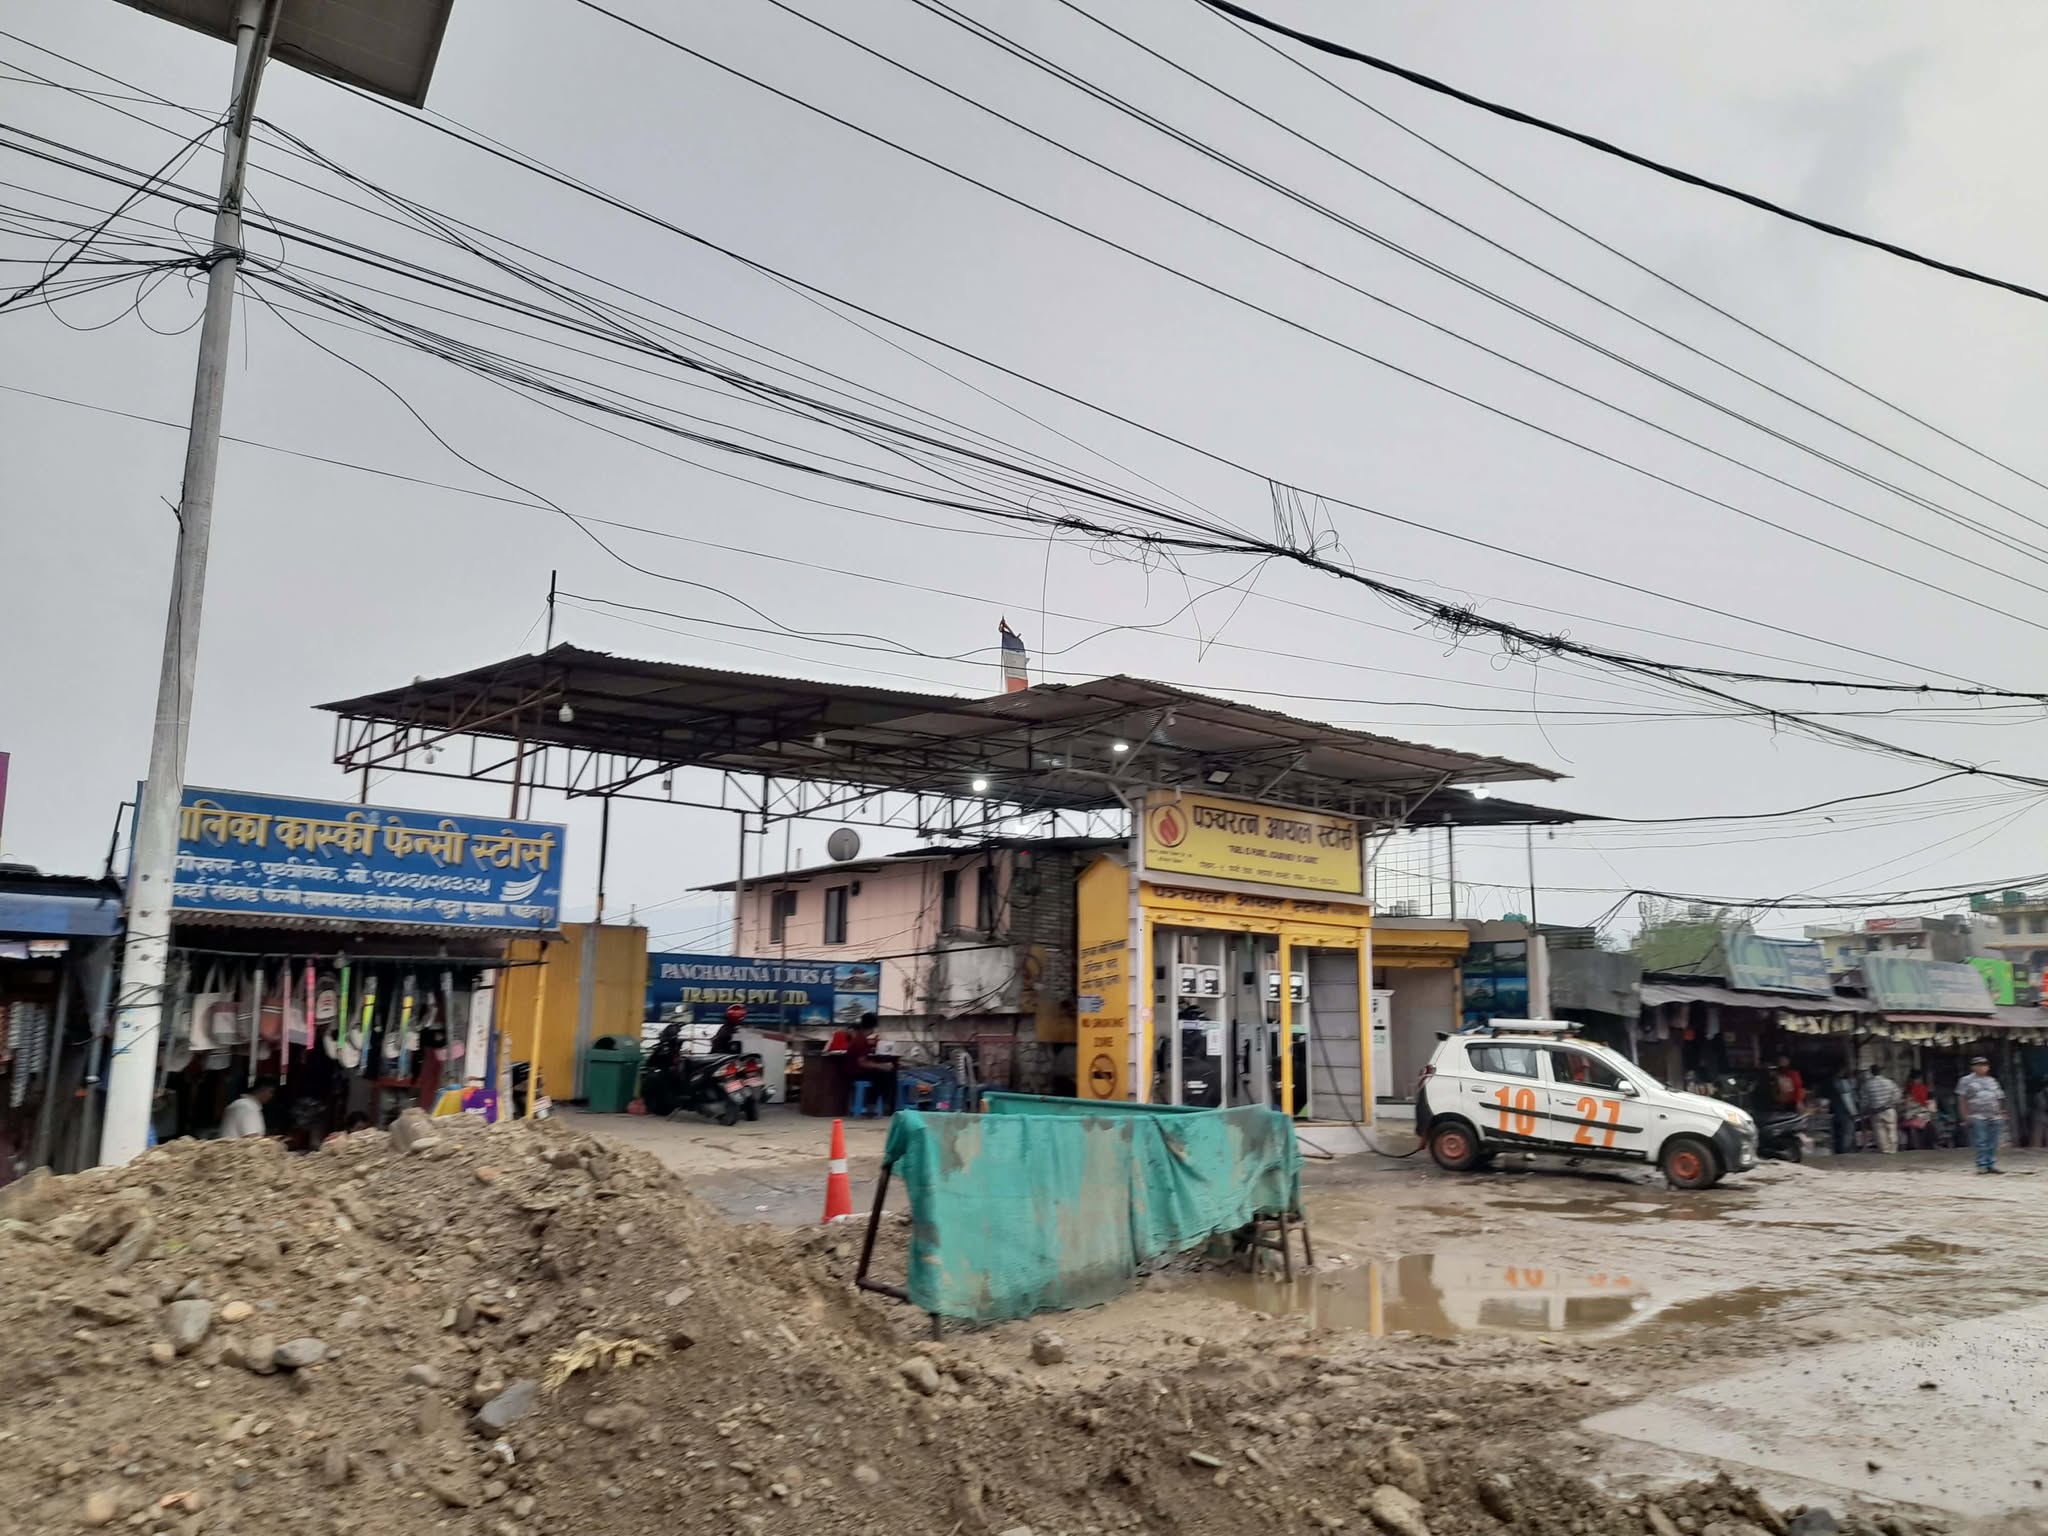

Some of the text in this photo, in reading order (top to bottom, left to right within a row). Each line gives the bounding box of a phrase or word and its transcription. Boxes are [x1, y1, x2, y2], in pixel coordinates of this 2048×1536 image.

[178, 798, 556, 875] ालिका कास्की फेन्सी स्टोर्स
[1494, 1086, 1621, 1147] 10 27
